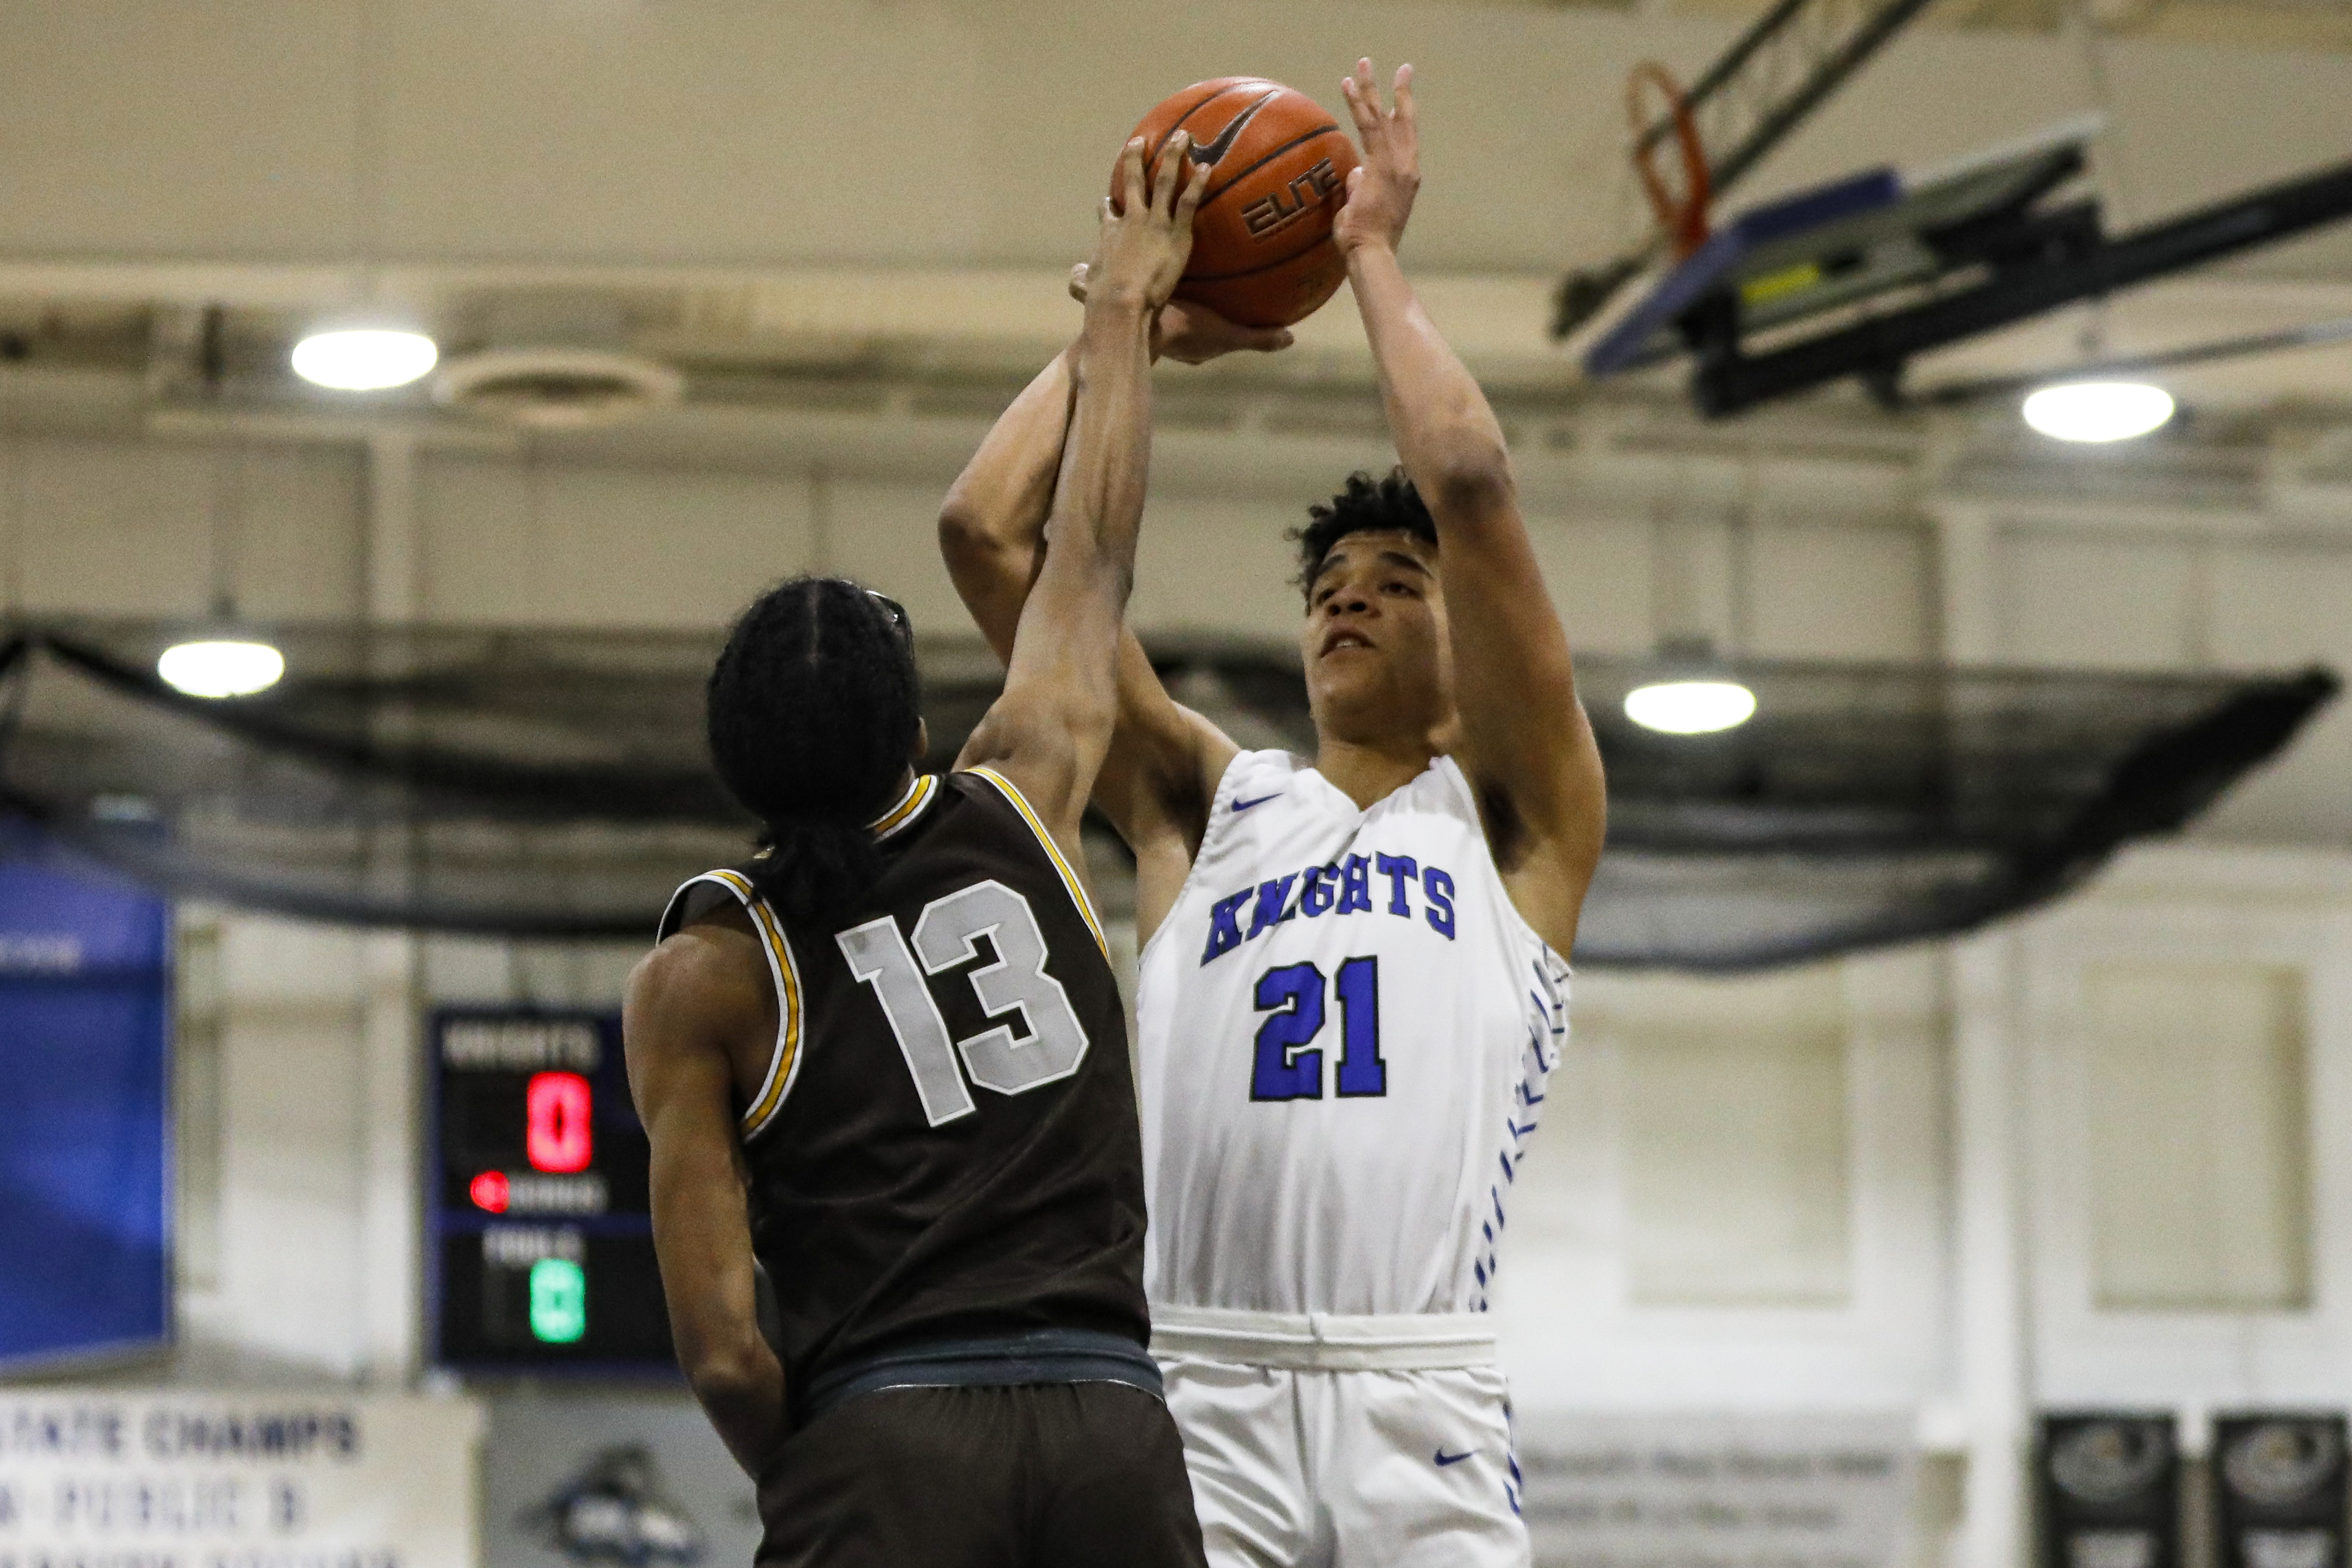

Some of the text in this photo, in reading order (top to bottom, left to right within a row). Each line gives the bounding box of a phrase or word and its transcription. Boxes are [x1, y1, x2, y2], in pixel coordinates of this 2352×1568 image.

[1241, 156, 1340, 237] ELITE
[1200, 851, 1455, 969] KNGHTS
[834, 879, 1090, 1127] 13
[1249, 955, 1387, 1102] 21
[527, 1071, 593, 1173] 0
[0, 1410, 362, 1460] TATE CHAMPS
